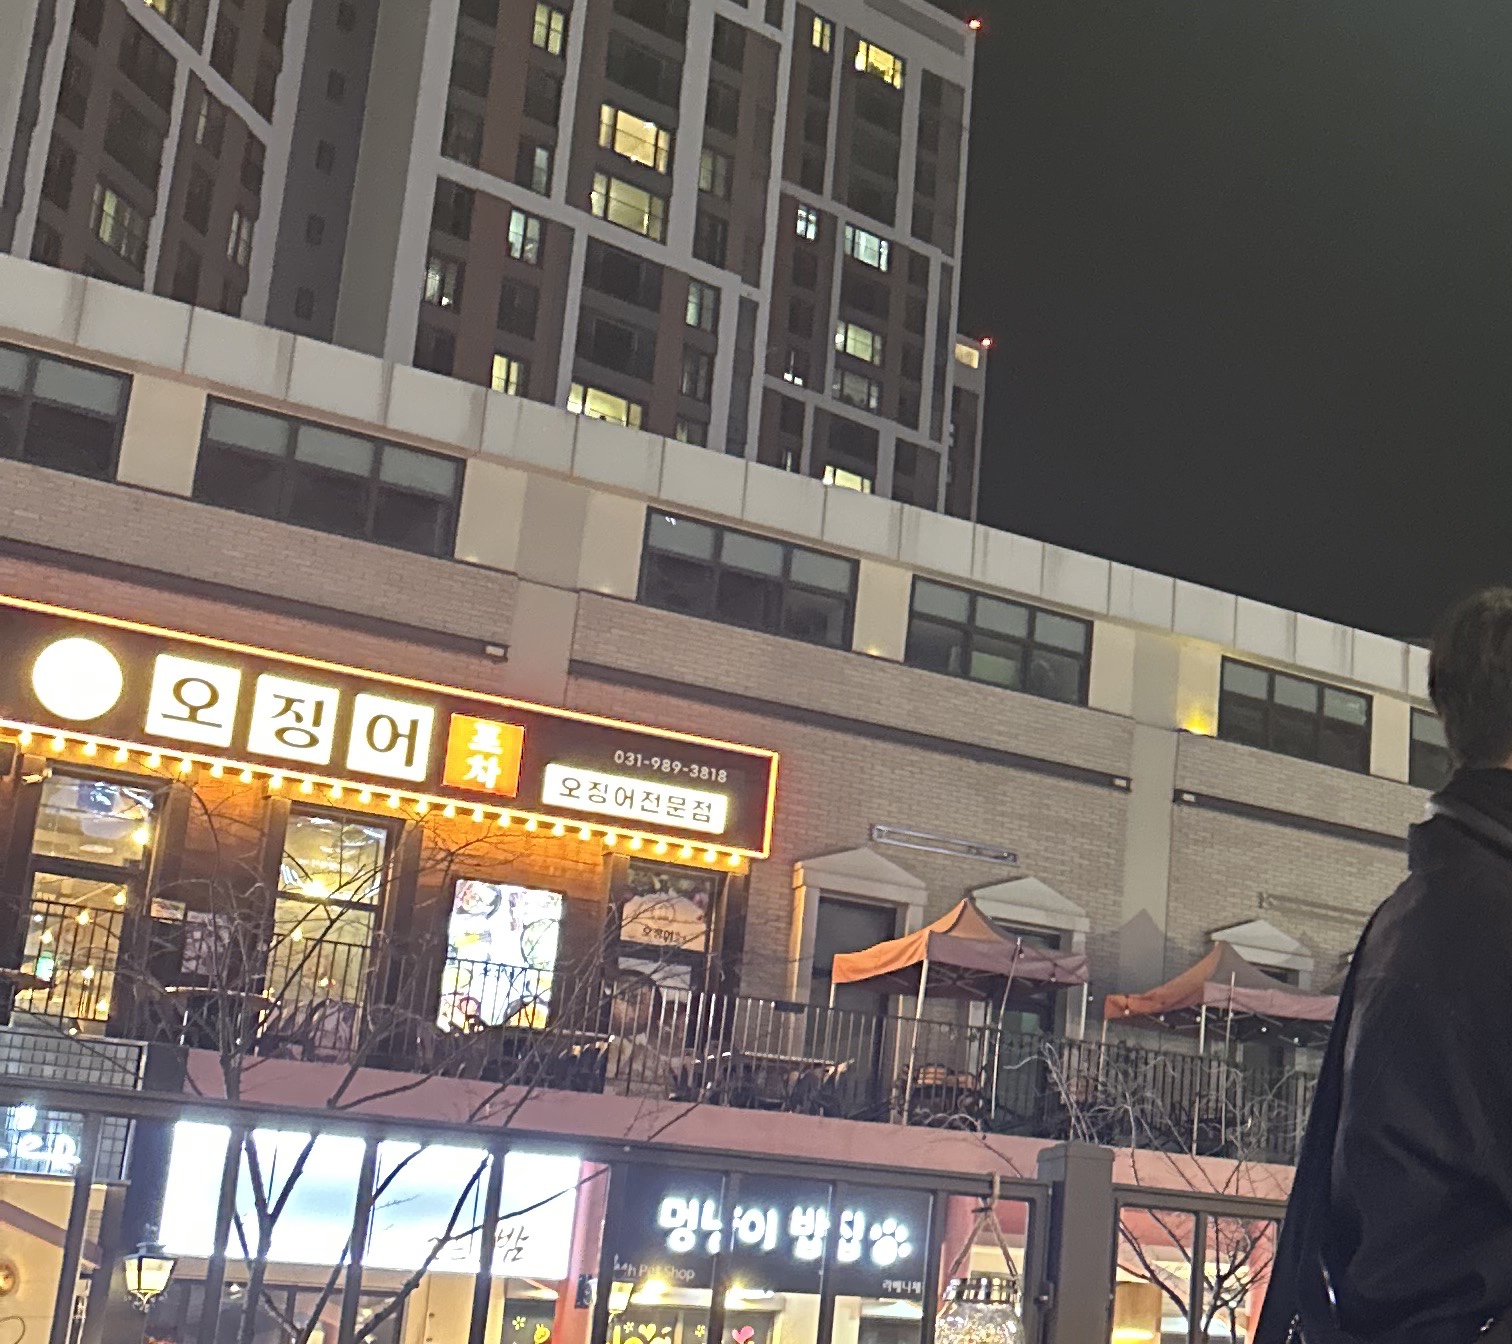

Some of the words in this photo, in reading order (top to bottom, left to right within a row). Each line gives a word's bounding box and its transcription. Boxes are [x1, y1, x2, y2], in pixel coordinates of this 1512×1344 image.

[161, 676, 420, 768] 오징어
[465, 721, 503, 789] 포차
[613, 749, 728, 783] 031-989-3818
[559, 777, 713, 824] 오징어전문점
